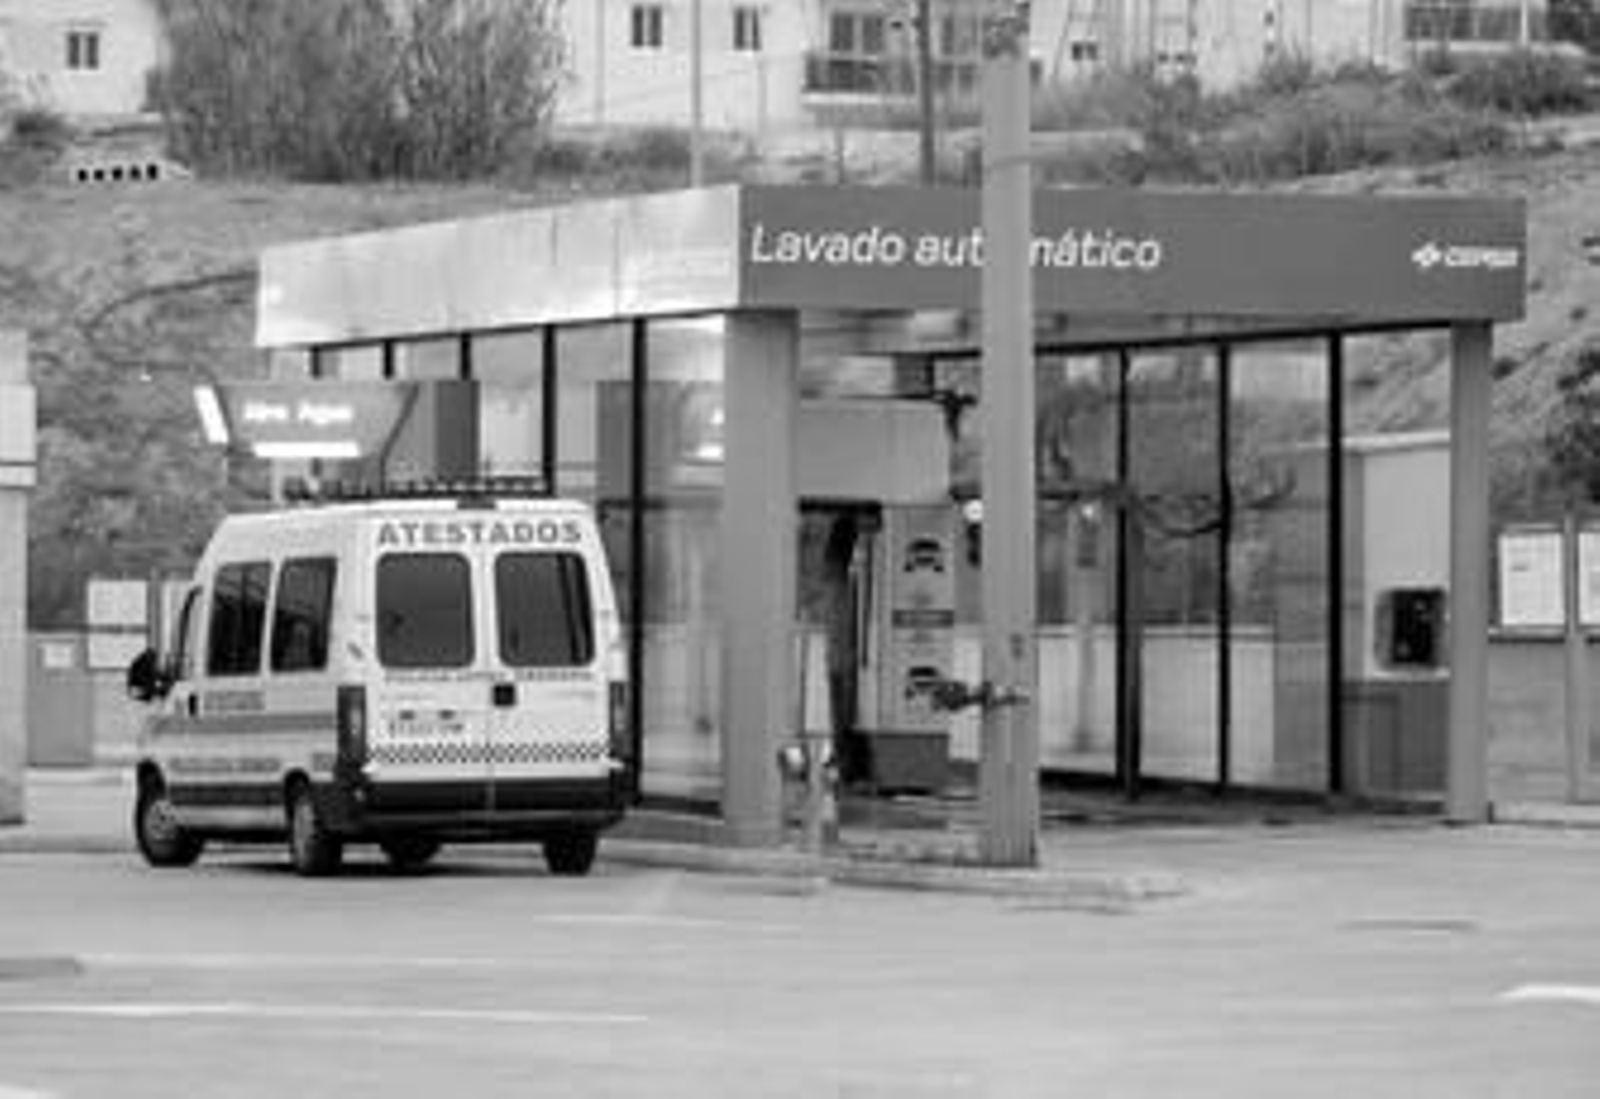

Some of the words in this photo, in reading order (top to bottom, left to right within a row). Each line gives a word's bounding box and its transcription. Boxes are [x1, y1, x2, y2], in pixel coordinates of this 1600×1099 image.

[750, 223, 905, 264] Lavado
[914, 226, 1162, 269] autmático
[378, 521, 582, 545] ATESTADOS
